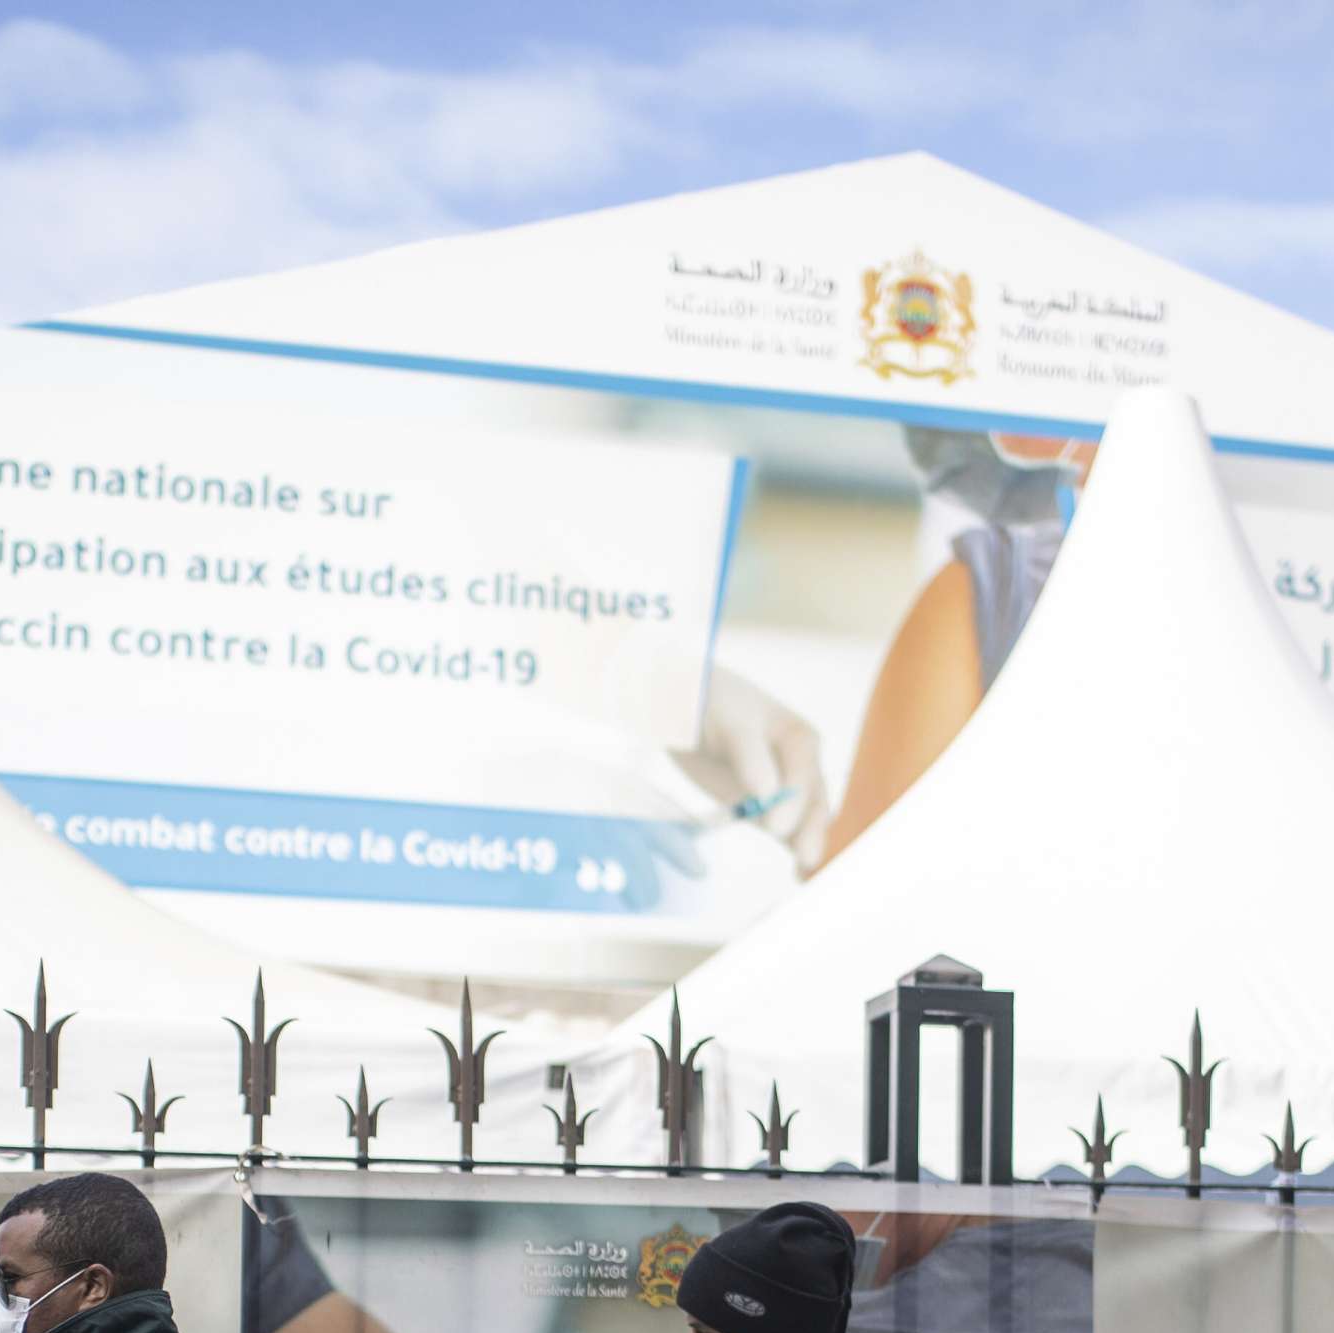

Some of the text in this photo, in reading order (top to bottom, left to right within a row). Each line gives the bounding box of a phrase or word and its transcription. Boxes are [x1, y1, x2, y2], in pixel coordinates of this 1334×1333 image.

[73, 462, 302, 513] nationale
[319, 485, 393, 519] sur
[186, 554, 269, 586] aux
[287, 553, 450, 603] études
[466, 571, 675, 624] cliniques
[109, 624, 270, 667] contre
[288, 632, 327, 671] la
[345, 635, 541, 686] Covid-19
[64, 813, 216, 854] combat
[224, 824, 354, 863] contre
[359, 827, 397, 865] la
[401, 828, 559, 876] Covid-19
[524, 1239, 628, 1263] وزارة الصحة
